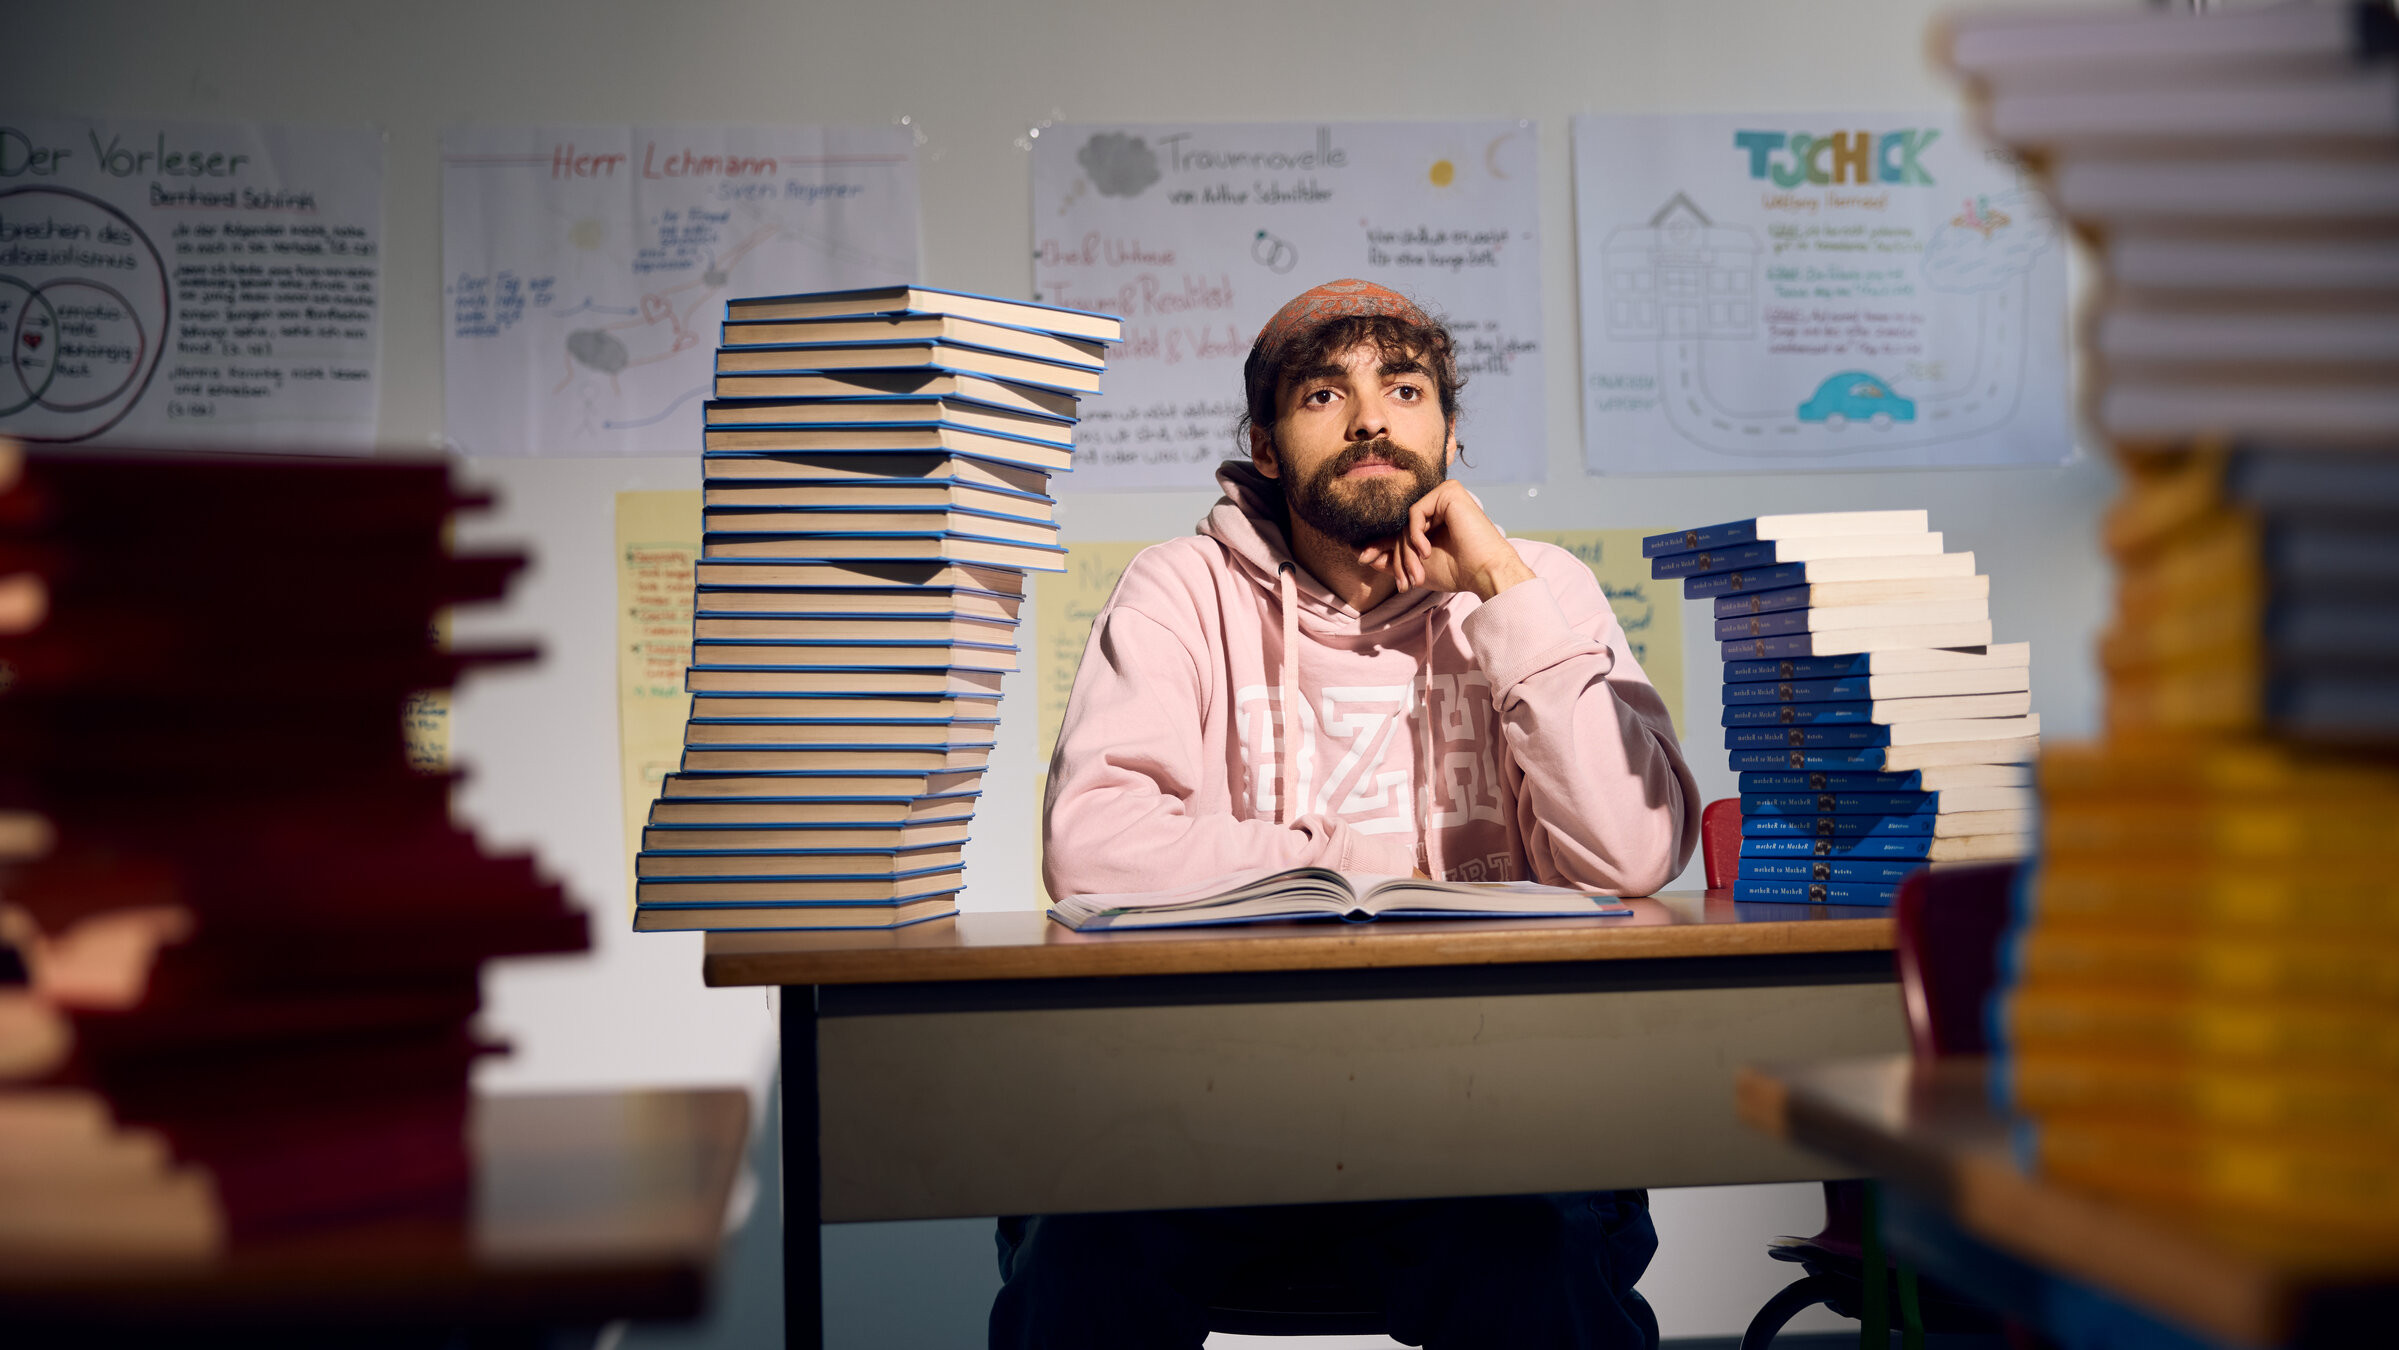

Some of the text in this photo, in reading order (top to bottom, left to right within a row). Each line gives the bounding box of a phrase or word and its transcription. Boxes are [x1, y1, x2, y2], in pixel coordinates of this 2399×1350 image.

[0, 127, 250, 178] Der Vorleser
[552, 144, 627, 179] Herr
[1158, 126, 1349, 174] Traumnovelle
[1784, 866, 1807, 874] MotheR
[1749, 887, 1771, 895] motheR
[1780, 887, 1803, 895] MotheR
